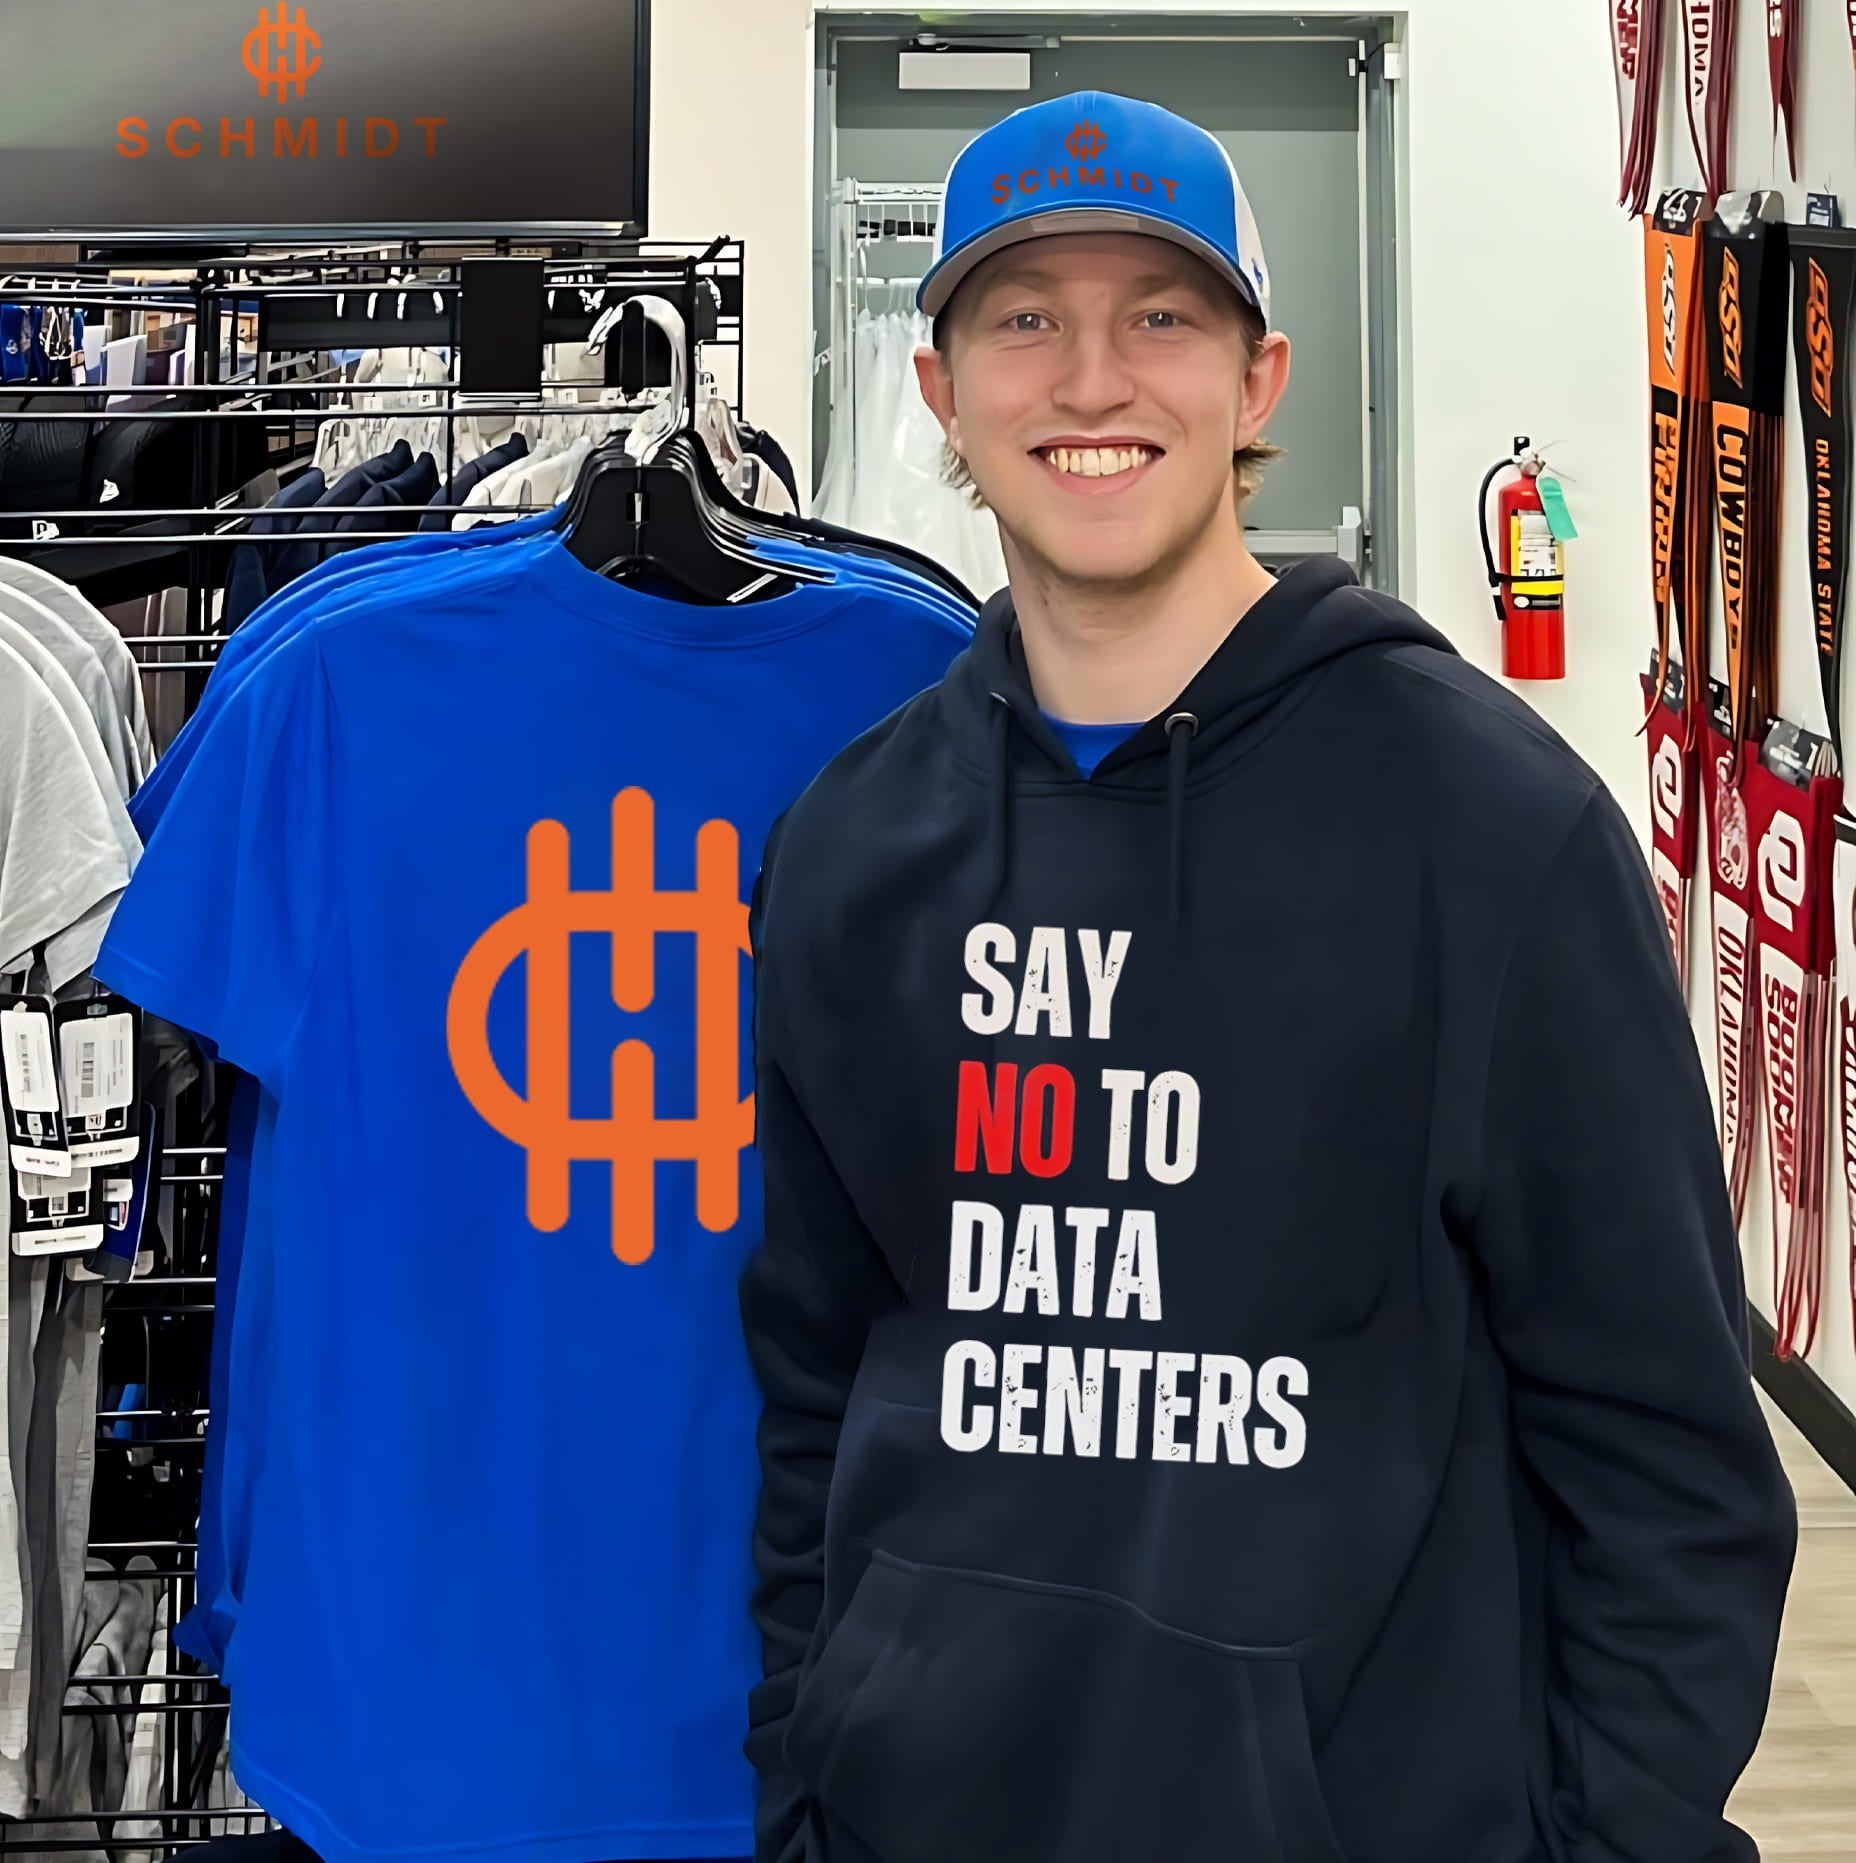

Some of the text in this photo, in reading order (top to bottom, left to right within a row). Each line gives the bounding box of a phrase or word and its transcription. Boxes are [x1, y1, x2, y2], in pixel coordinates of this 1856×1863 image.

[115, 116, 447, 158] SCHMIDT
[991, 167, 1179, 204] SCHMIDT
[961, 922, 1132, 1039] SAY
[954, 1060, 1201, 1184] NO TO
[947, 1200, 1162, 1321] DATA
[940, 1339, 1309, 1469] CENTERS
